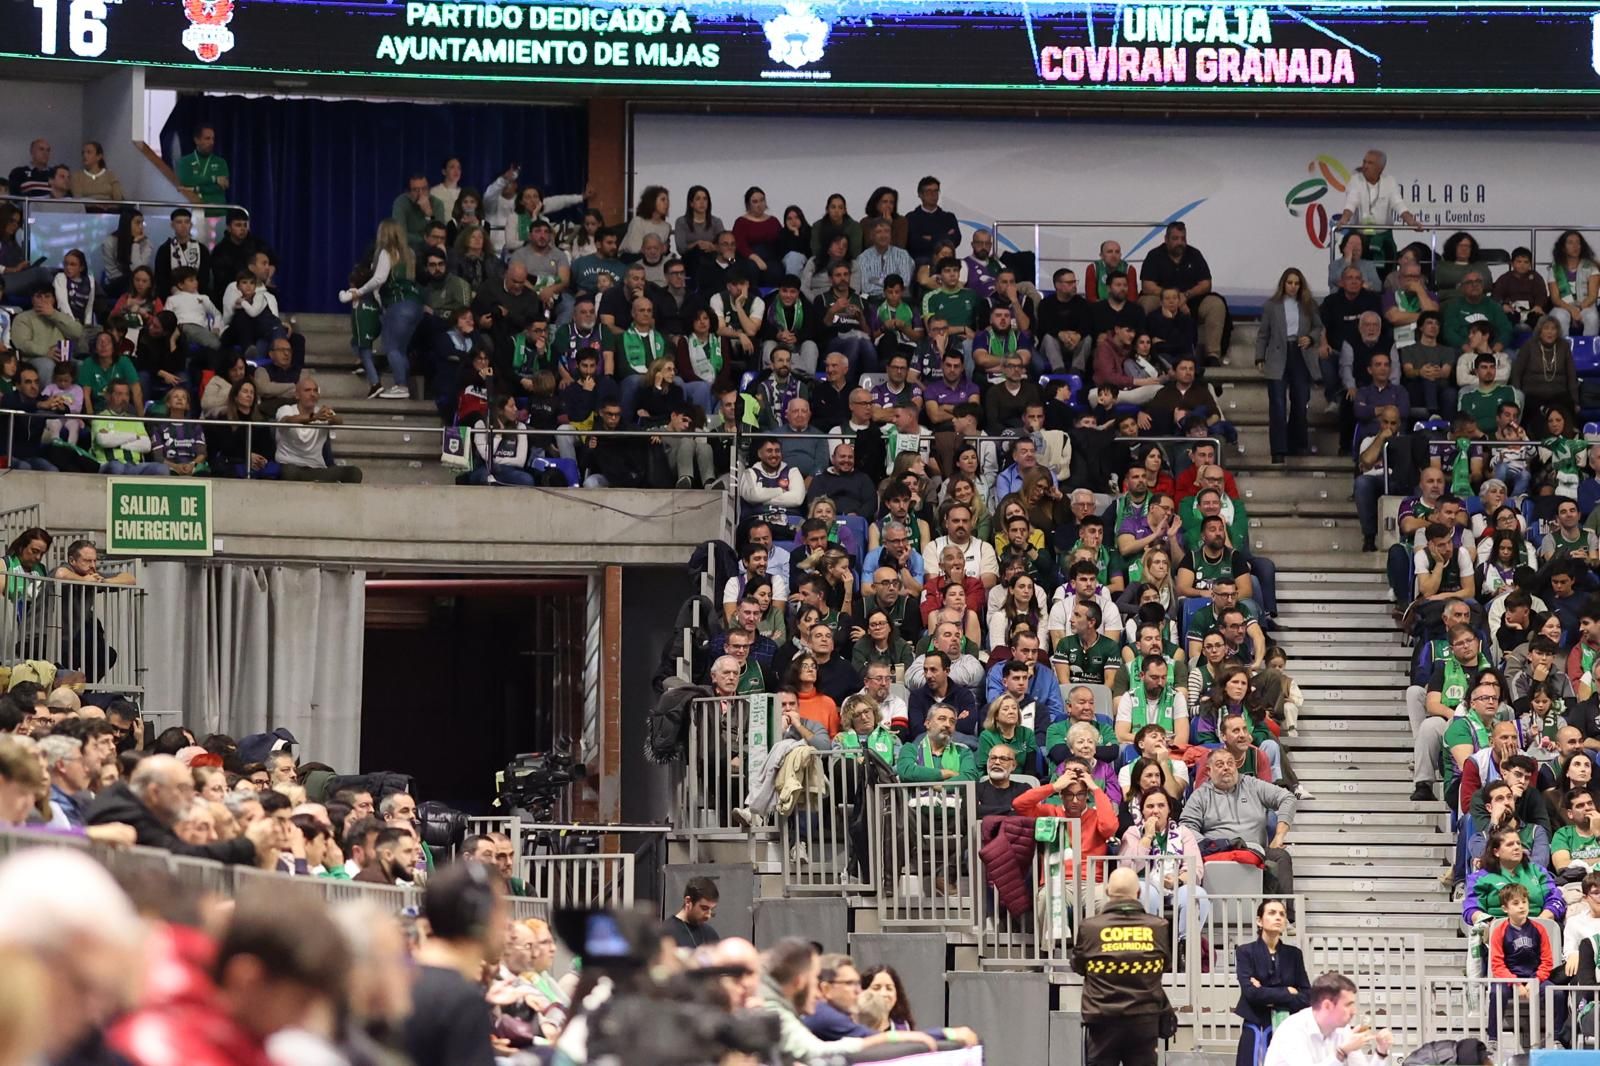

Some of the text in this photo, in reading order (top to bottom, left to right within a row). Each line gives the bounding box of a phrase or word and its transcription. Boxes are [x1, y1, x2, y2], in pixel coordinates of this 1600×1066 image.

[33, 0, 107, 57] 16
[406, 2, 692, 34] PARTIDO DEDICADO A
[1122, 7, 1272, 43] UNICAJA
[594, 42, 629, 66] DE
[635, 42, 720, 68] MIJAS
[1040, 46, 1355, 84] COVIRAN GRANADA
[120, 495, 198, 517] SALIDA DE
[114, 519, 204, 541] EMERGENCIA
[1100, 926, 1154, 942] COFER
[1101, 942, 1155, 952] SEGURIDAD
